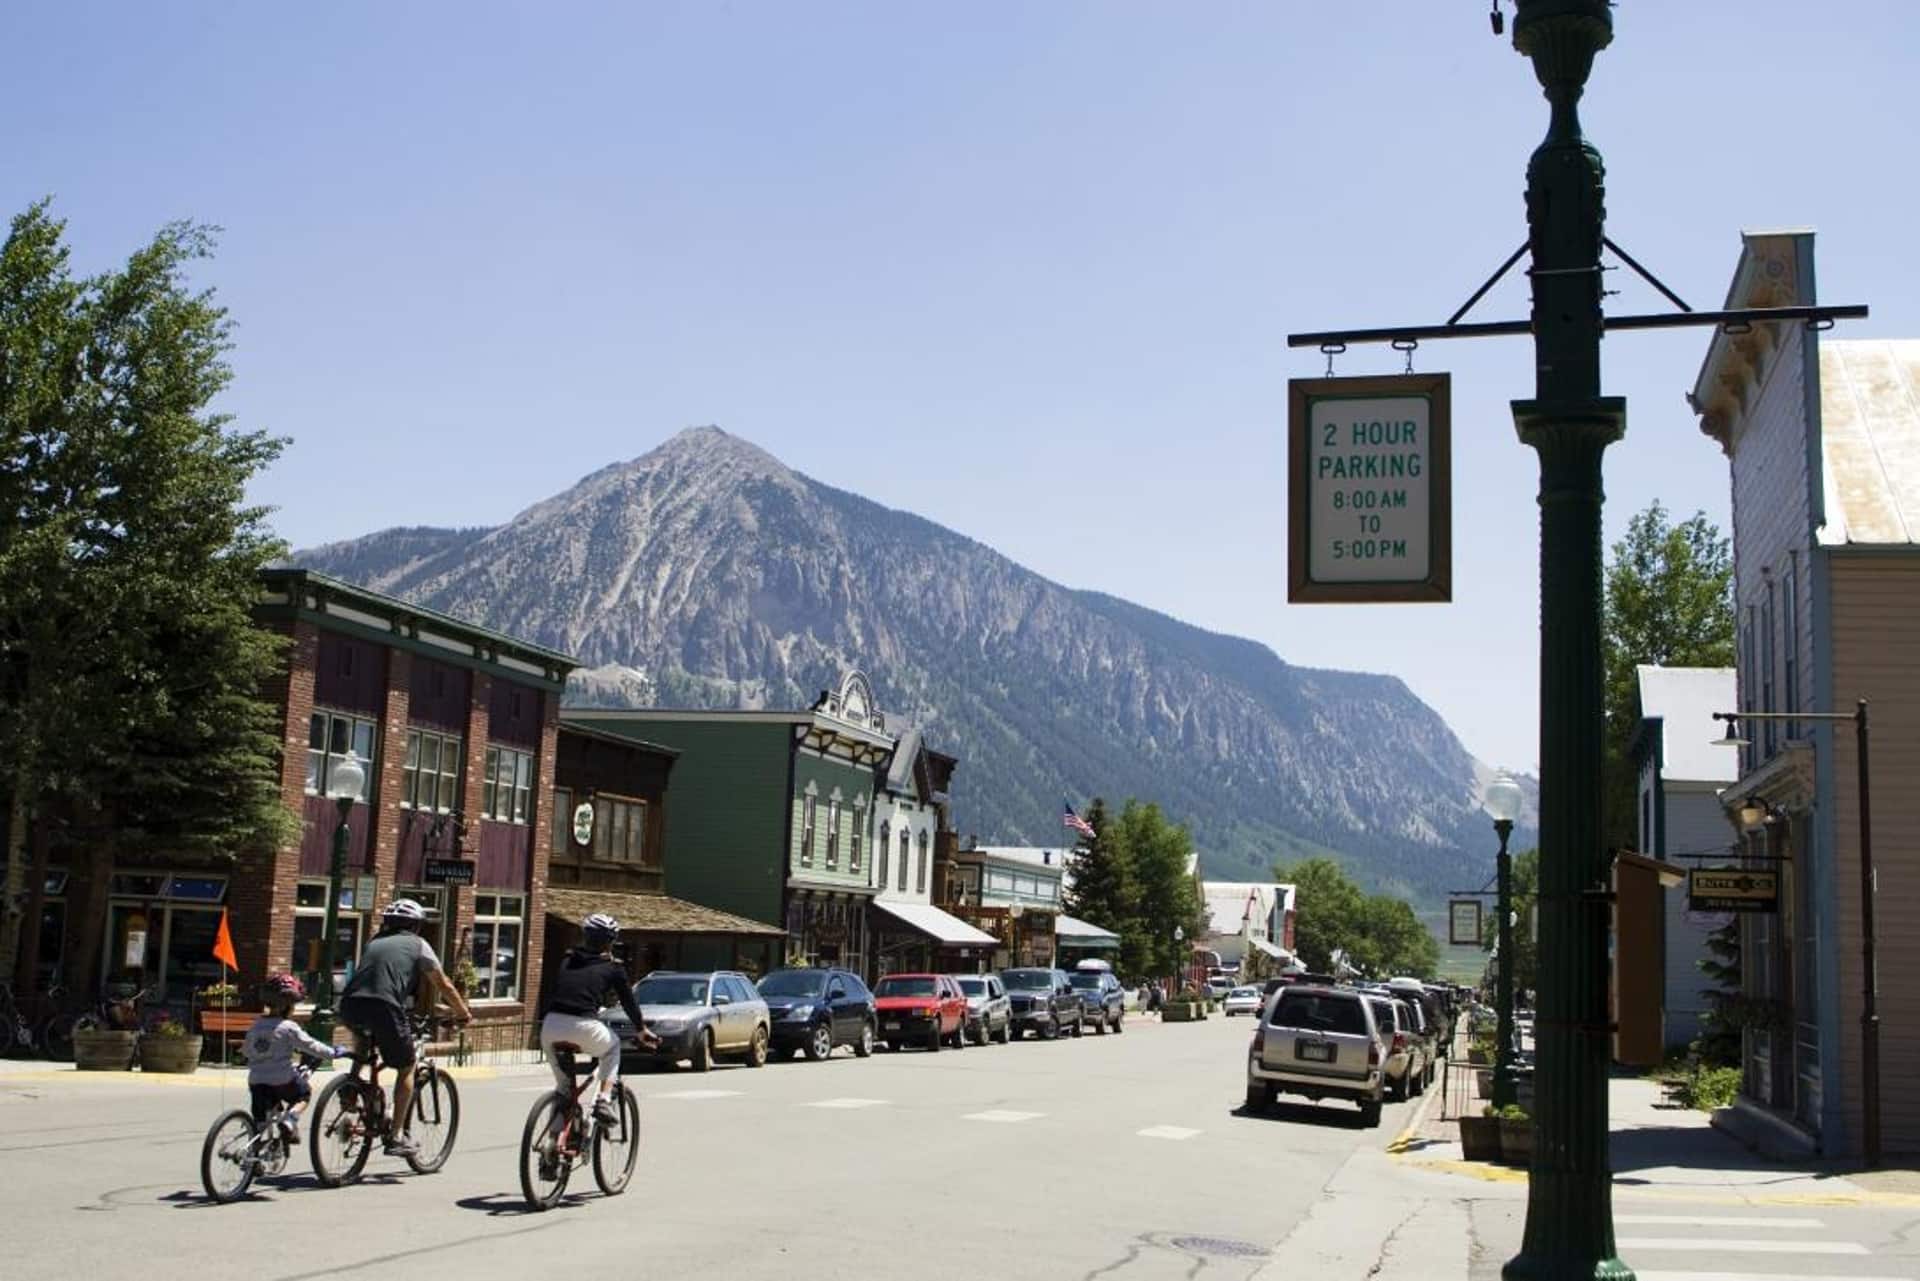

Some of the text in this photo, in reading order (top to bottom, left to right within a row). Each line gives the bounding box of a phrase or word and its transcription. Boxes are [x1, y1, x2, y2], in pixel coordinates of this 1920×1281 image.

[1323, 421, 1417, 447] 2 HOUR
[1318, 453, 1421, 479] PARKING
[1359, 515, 1381, 533] TO
